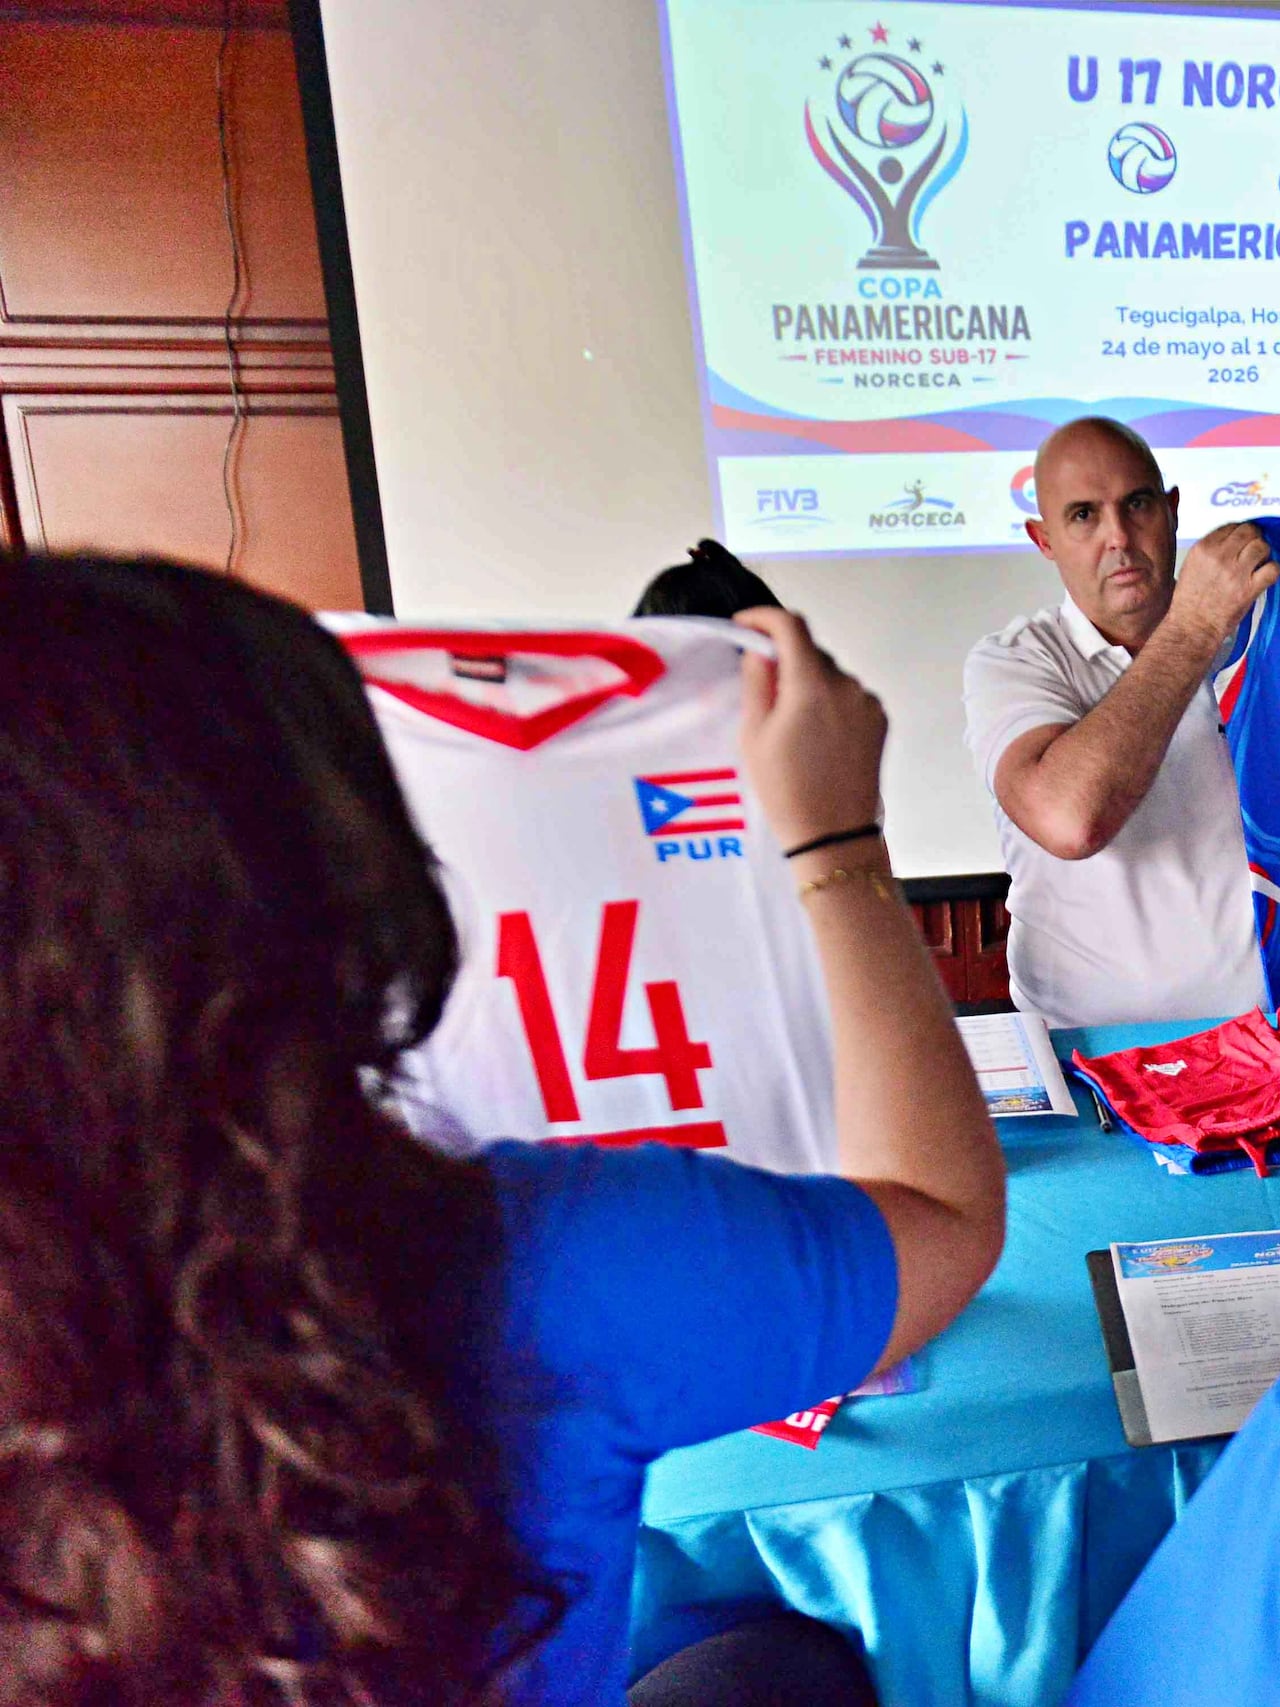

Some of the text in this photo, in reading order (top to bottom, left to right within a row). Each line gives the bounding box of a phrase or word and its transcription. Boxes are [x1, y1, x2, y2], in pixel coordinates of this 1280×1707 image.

[1067, 55, 1098, 103] U
[1119, 58, 1162, 105] 17
[858, 277, 943, 299] COPA
[772, 303, 1032, 341] PANAMERICANA
[1116, 306, 1245, 328] Tegucigalpa,
[815, 349, 997, 365] FEMENINO SUB-17
[1101, 340, 1127, 358] 24
[1133, 338, 1160, 355] de
[1167, 341, 1225, 360] mayo
[1231, 338, 1250, 356] al
[1257, 341, 1267, 355] 1
[854, 373, 961, 388] NORCECA
[1207, 366, 1259, 384] 2026
[757, 488, 819, 513] FIVB
[869, 511, 966, 528] NORCECA
[655, 836, 744, 863] PUR
[496, 899, 713, 1123] 14
